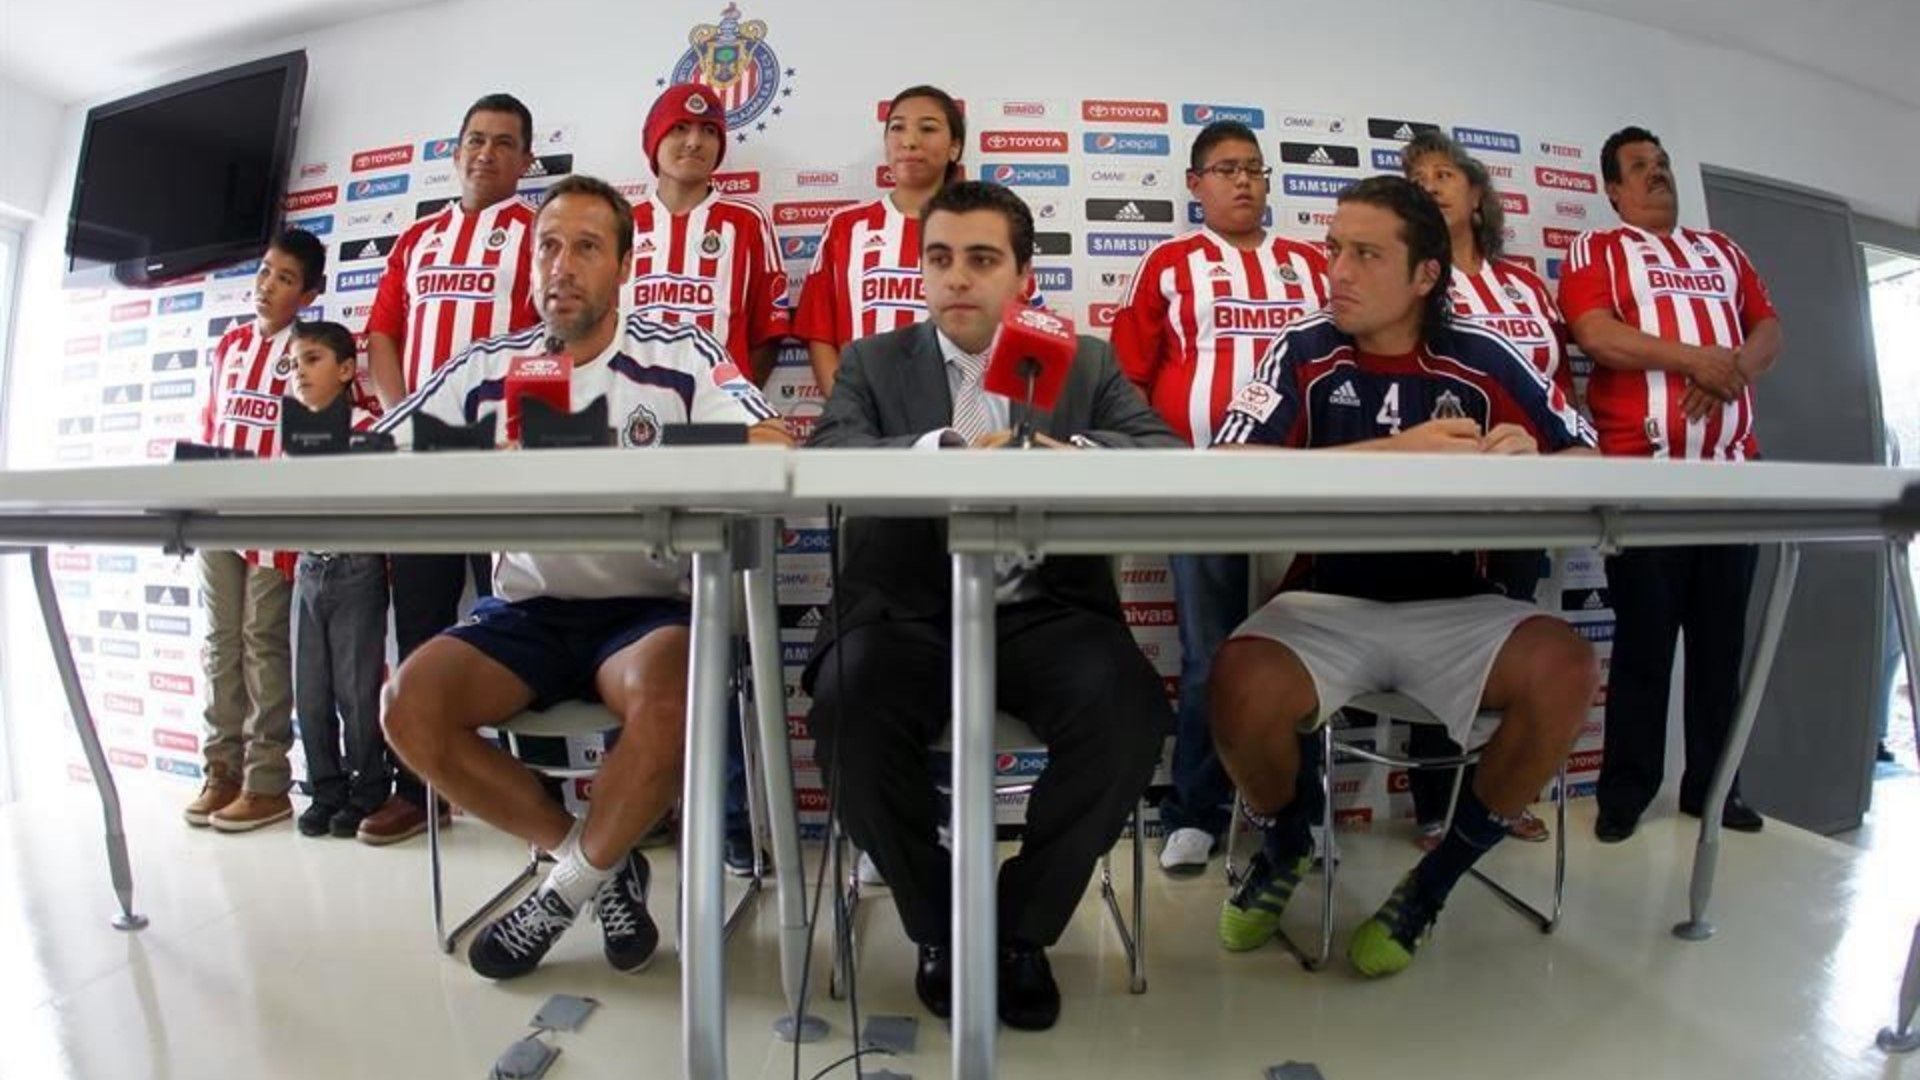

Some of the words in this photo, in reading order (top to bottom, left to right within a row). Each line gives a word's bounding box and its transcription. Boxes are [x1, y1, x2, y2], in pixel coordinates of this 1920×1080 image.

[1109, 106, 1161, 118] TOYOTA
[1008, 137, 1061, 147] TOYOTA
[1119, 138, 1157, 150] pepsi
[1457, 131, 1516, 149] SAMSUNG
[371, 150, 409, 163] TOYOTA
[1289, 180, 1346, 193] SAMSU
[1541, 171, 1592, 190] Chivas
[801, 207, 834, 218] TOYO
[1312, 213, 1336, 225] TEC
[1093, 238, 1156, 251] SAMSUN
[416, 273, 495, 296] BIMBO
[1648, 270, 1726, 292] BIMBO
[634, 282, 714, 306] BIMBO
[1376, 382, 1402, 436] 4
